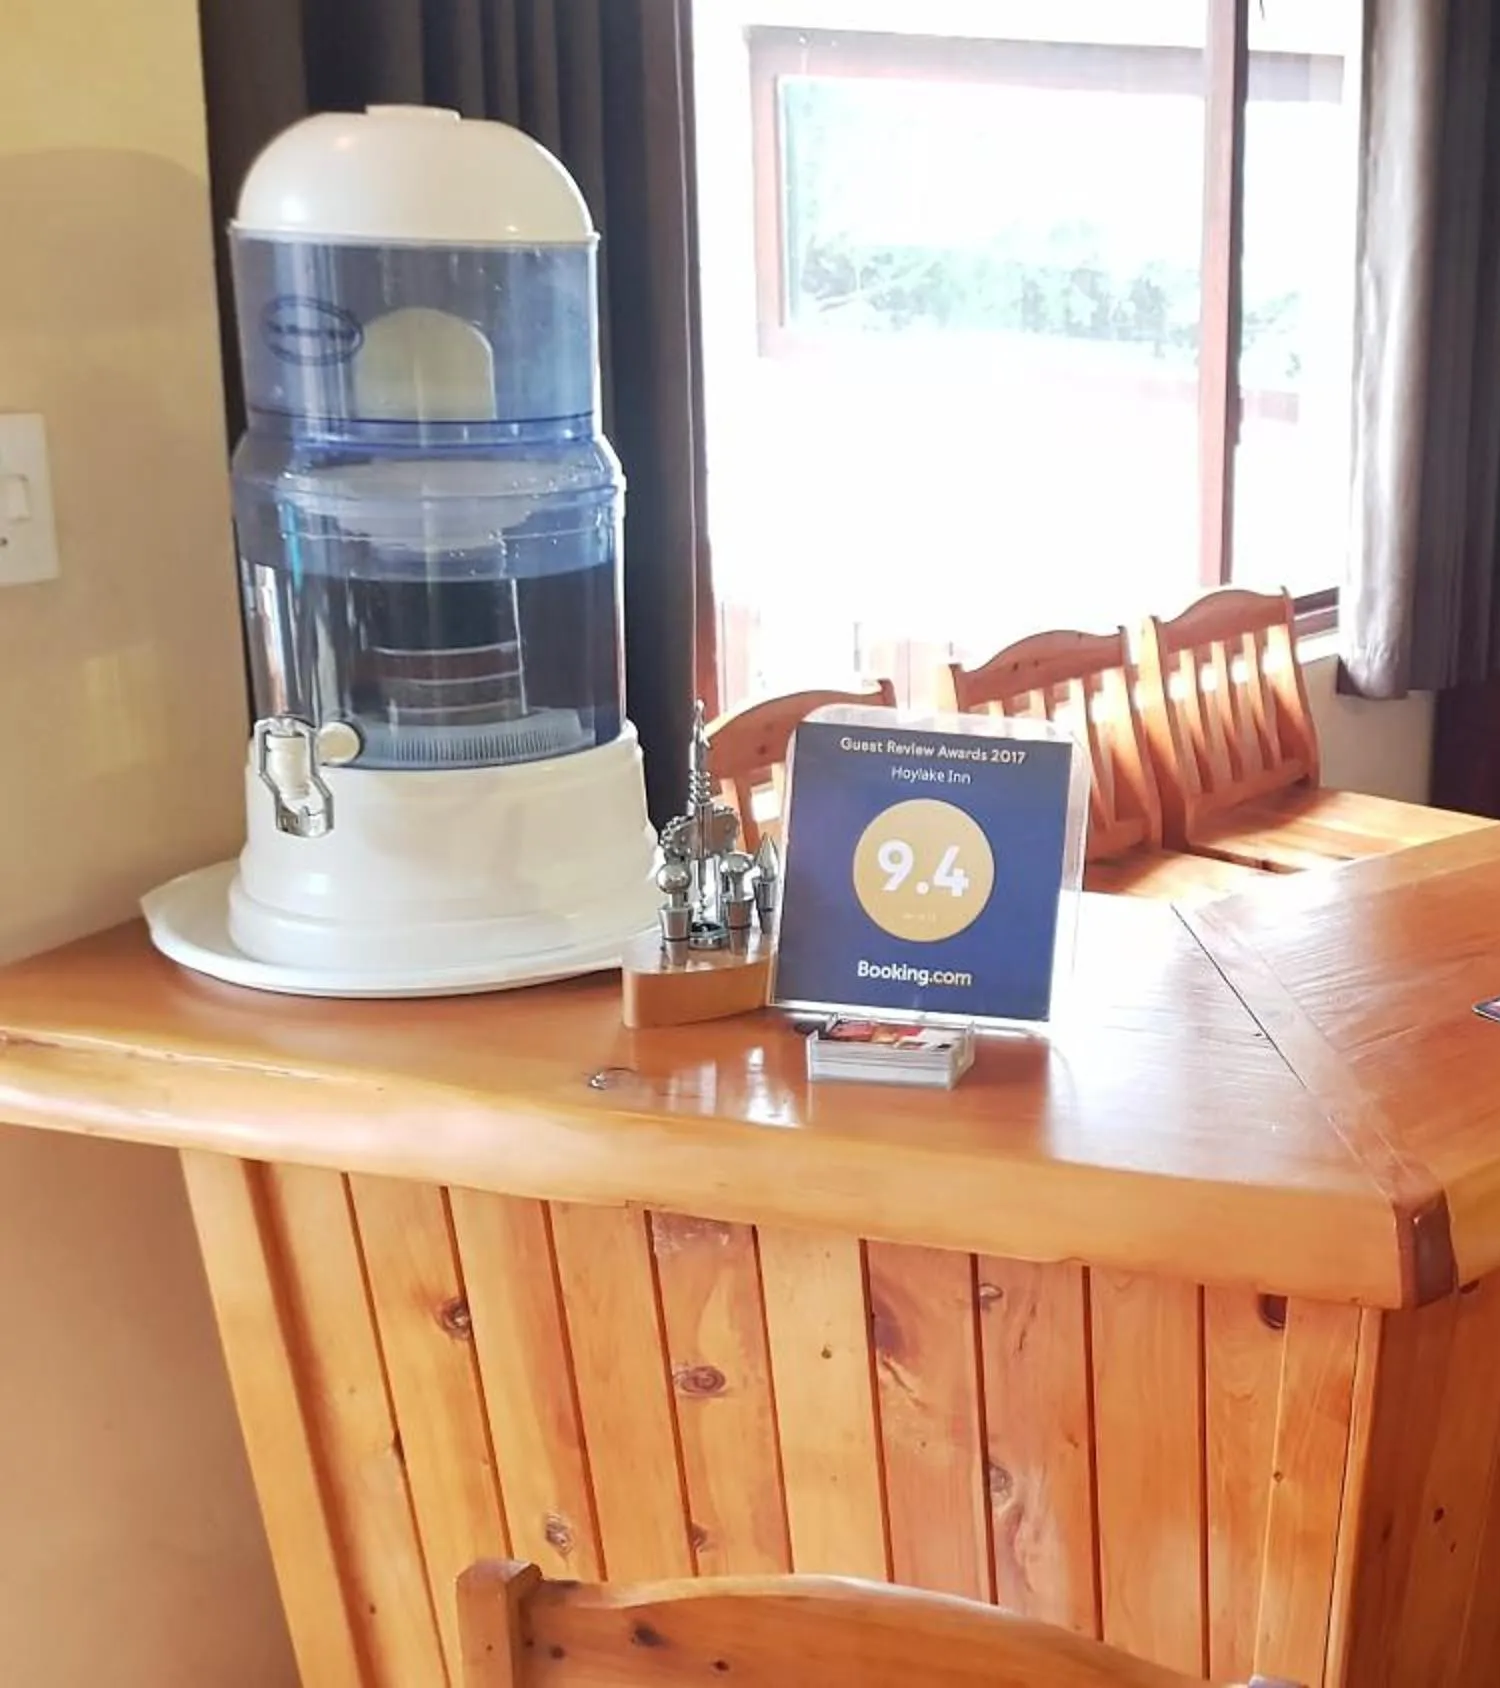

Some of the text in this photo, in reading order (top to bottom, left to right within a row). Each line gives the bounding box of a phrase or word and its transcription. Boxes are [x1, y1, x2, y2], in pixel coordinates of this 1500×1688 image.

[840, 737, 1027, 765] Guest Review Awards 2017
[891, 765, 972, 785] Hoylake Inn
[877, 839, 970, 898] 9.4
[857, 960, 972, 986] Booking.com
